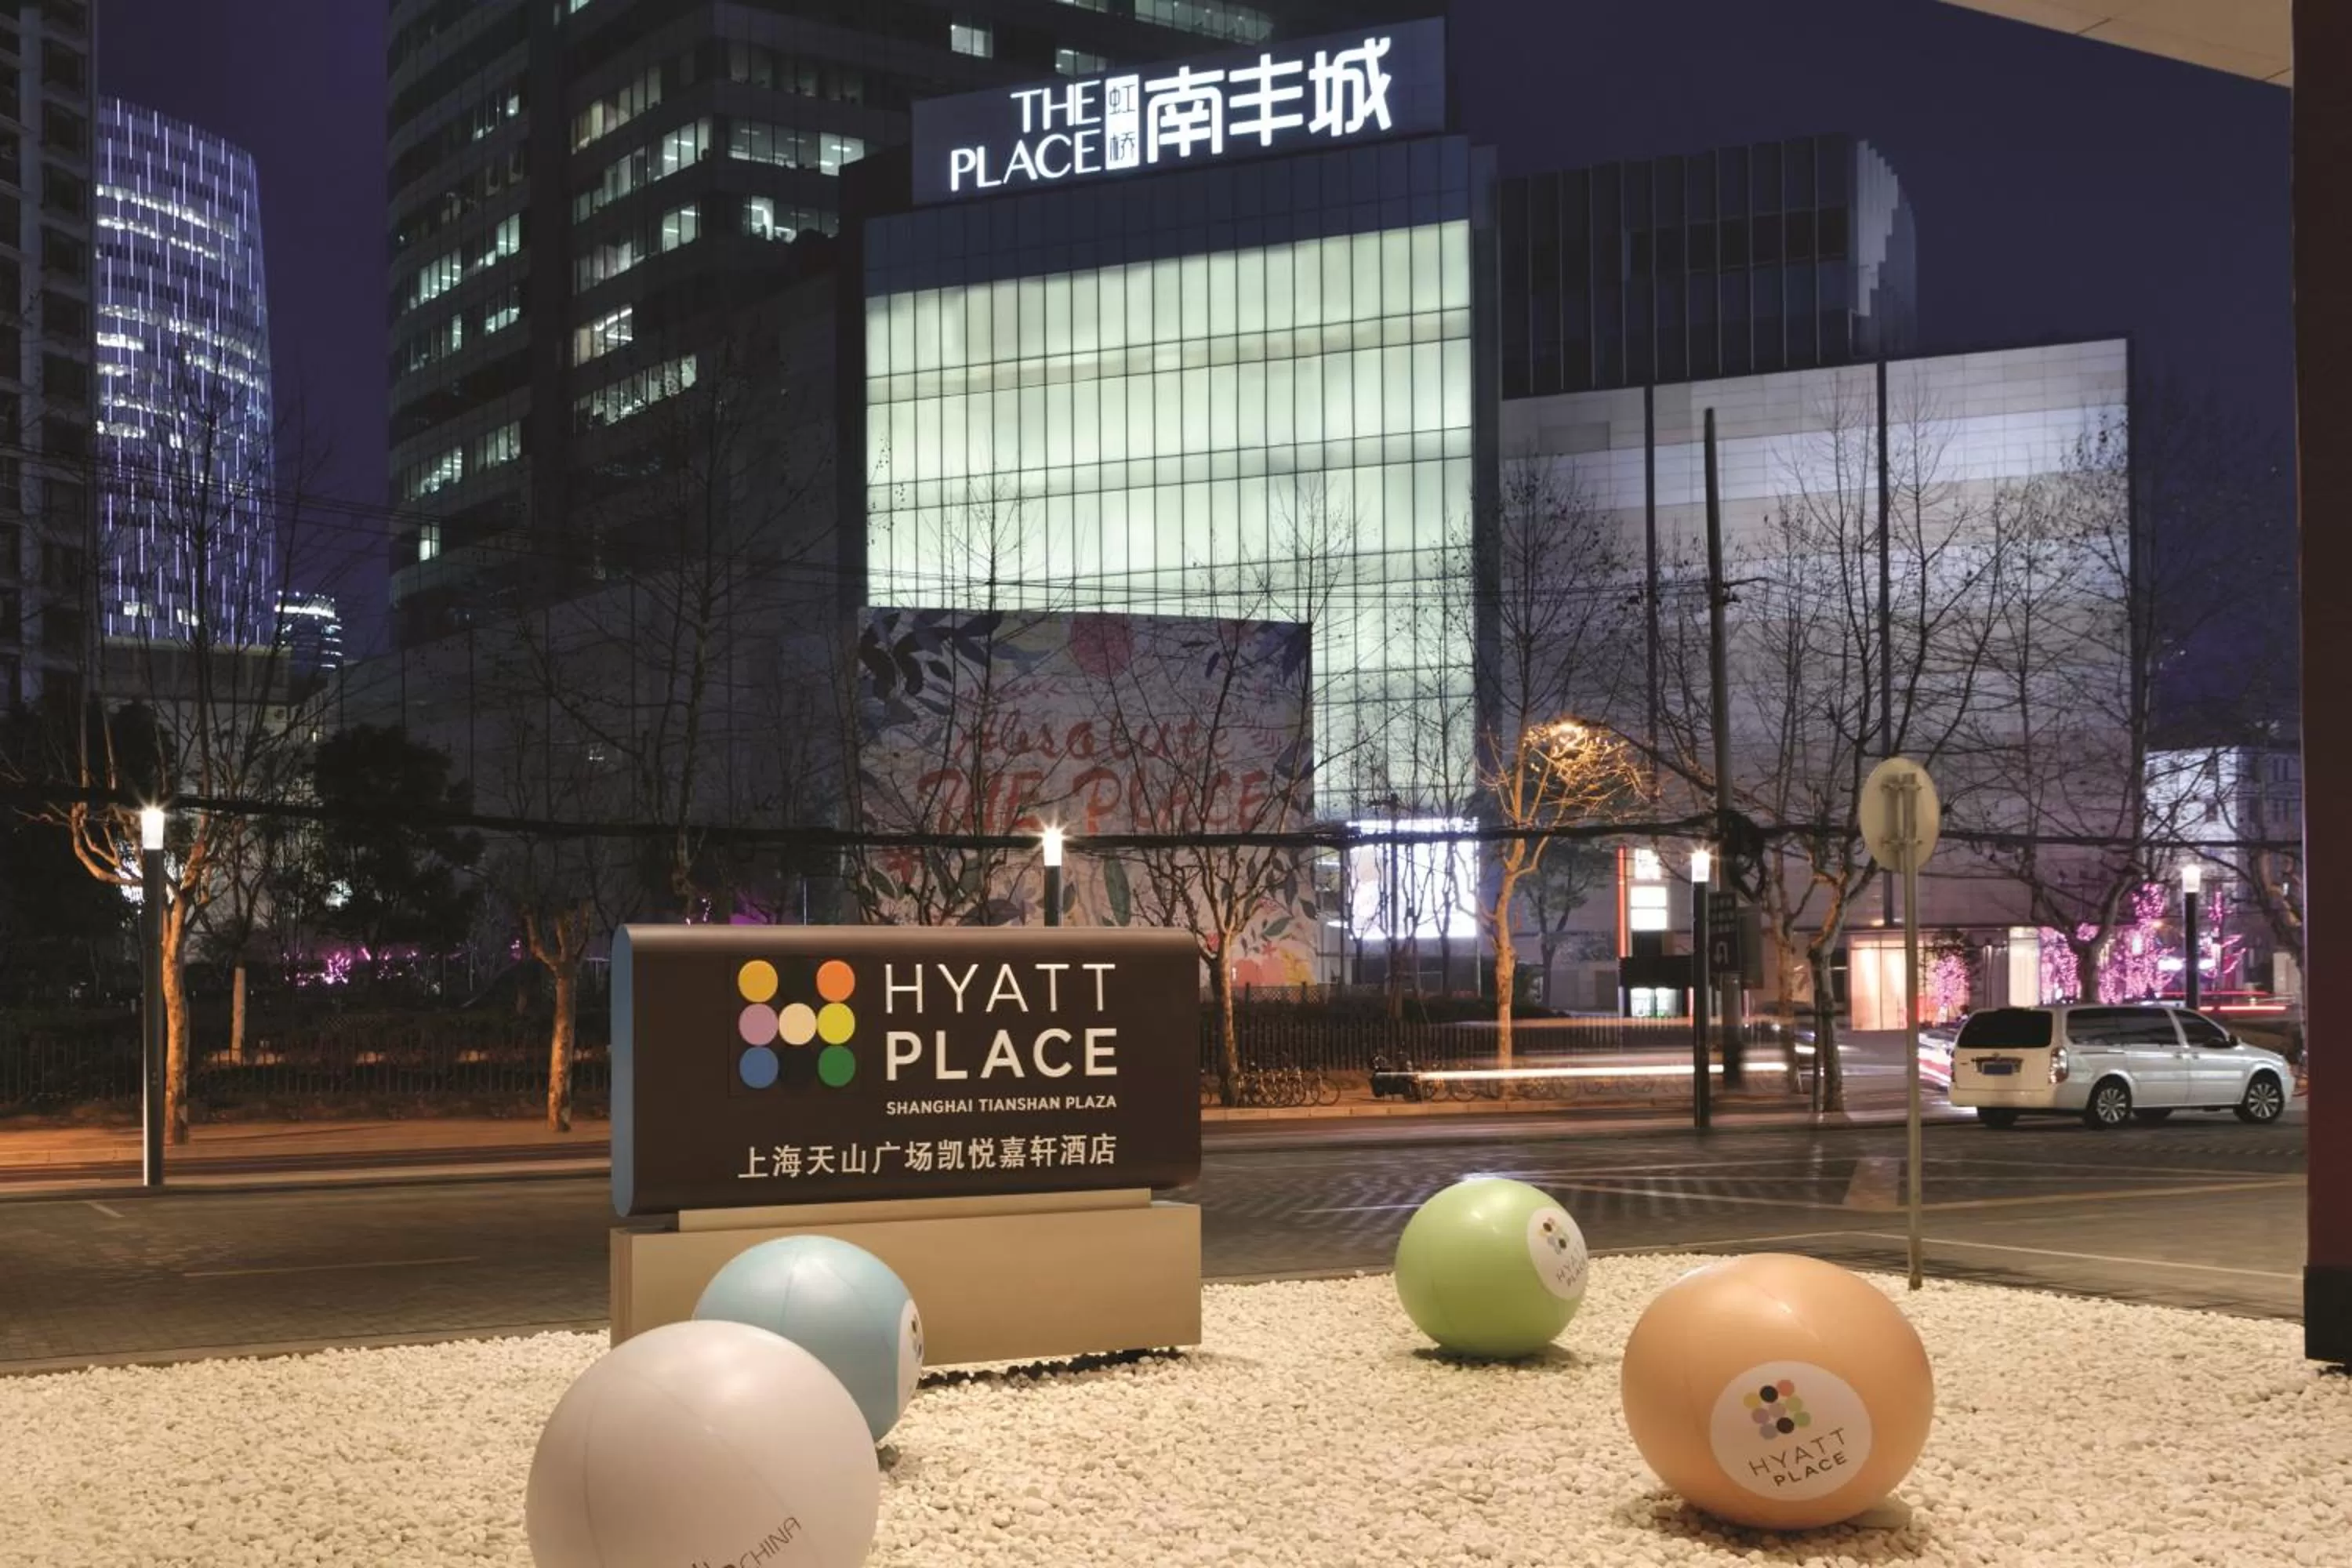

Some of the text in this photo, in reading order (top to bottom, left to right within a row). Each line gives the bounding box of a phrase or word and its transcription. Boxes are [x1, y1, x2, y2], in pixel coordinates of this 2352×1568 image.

[1010, 80, 1102, 133] THE
[1107, 84, 1137, 162] 虹桥
[1144, 37, 1392, 165] 南丰城
[950, 129, 1102, 191] PLACE
[917, 765, 1268, 837] THE PLACE
[885, 963, 1116, 1014] HYATT
[886, 1028, 1117, 1081] PLACE
[886, 1094, 1117, 1116] SHANGHAI TIANSHAN PLAZA
[738, 1133, 1117, 1179] 上海天山广场凯悦嘉轩酒店
[1748, 1427, 1845, 1475] HYATT
[1773, 1452, 1846, 1486] PLACE
